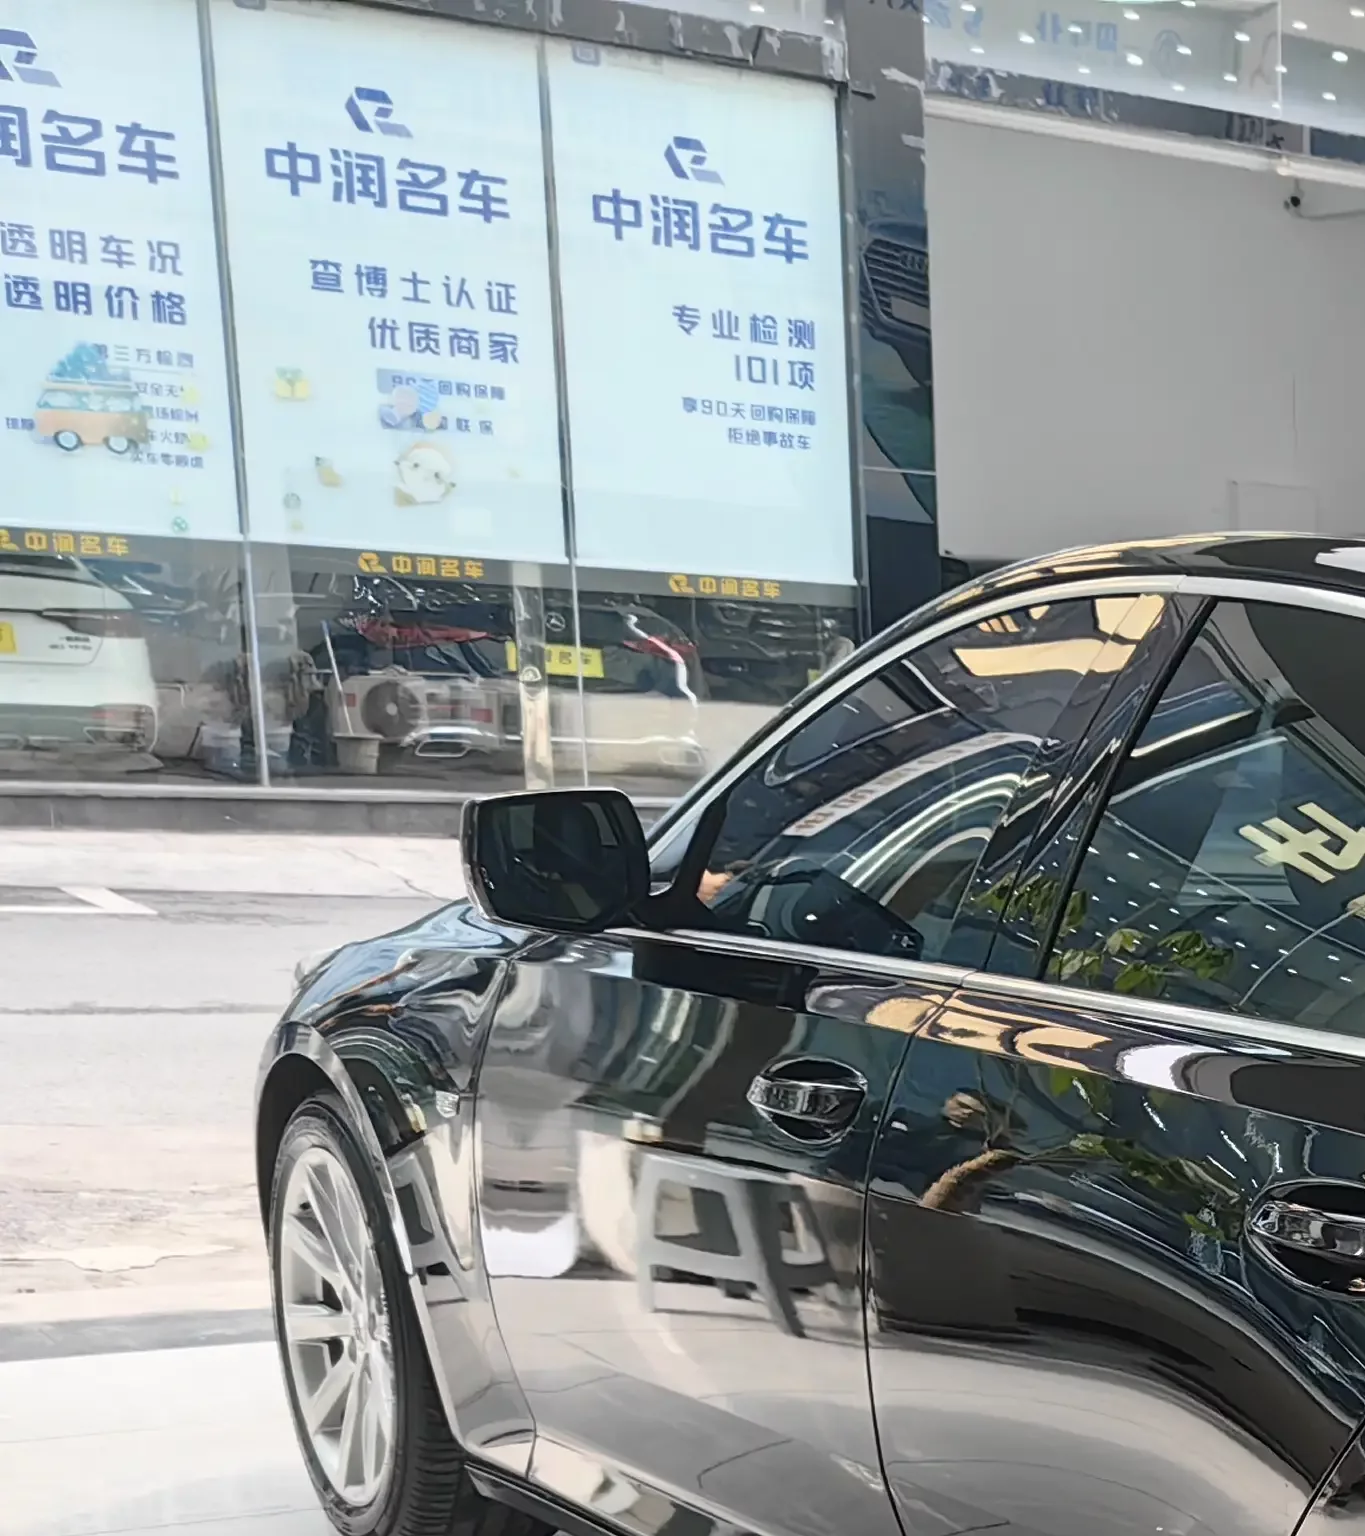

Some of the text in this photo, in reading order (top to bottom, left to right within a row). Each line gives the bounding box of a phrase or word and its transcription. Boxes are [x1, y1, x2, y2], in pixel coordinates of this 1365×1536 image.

[264, 141, 510, 224] 中润名车
[0, 221, 184, 276] 透明车况
[592, 187, 809, 264] 中润名车
[4, 273, 188, 326] 透明价格
[309, 258, 519, 316] 查博士认证
[367, 316, 520, 365] 优质商家
[672, 303, 816, 351] 专业检测
[391, 555, 485, 578] 中润名车
[698, 576, 781, 599] 中润名车
